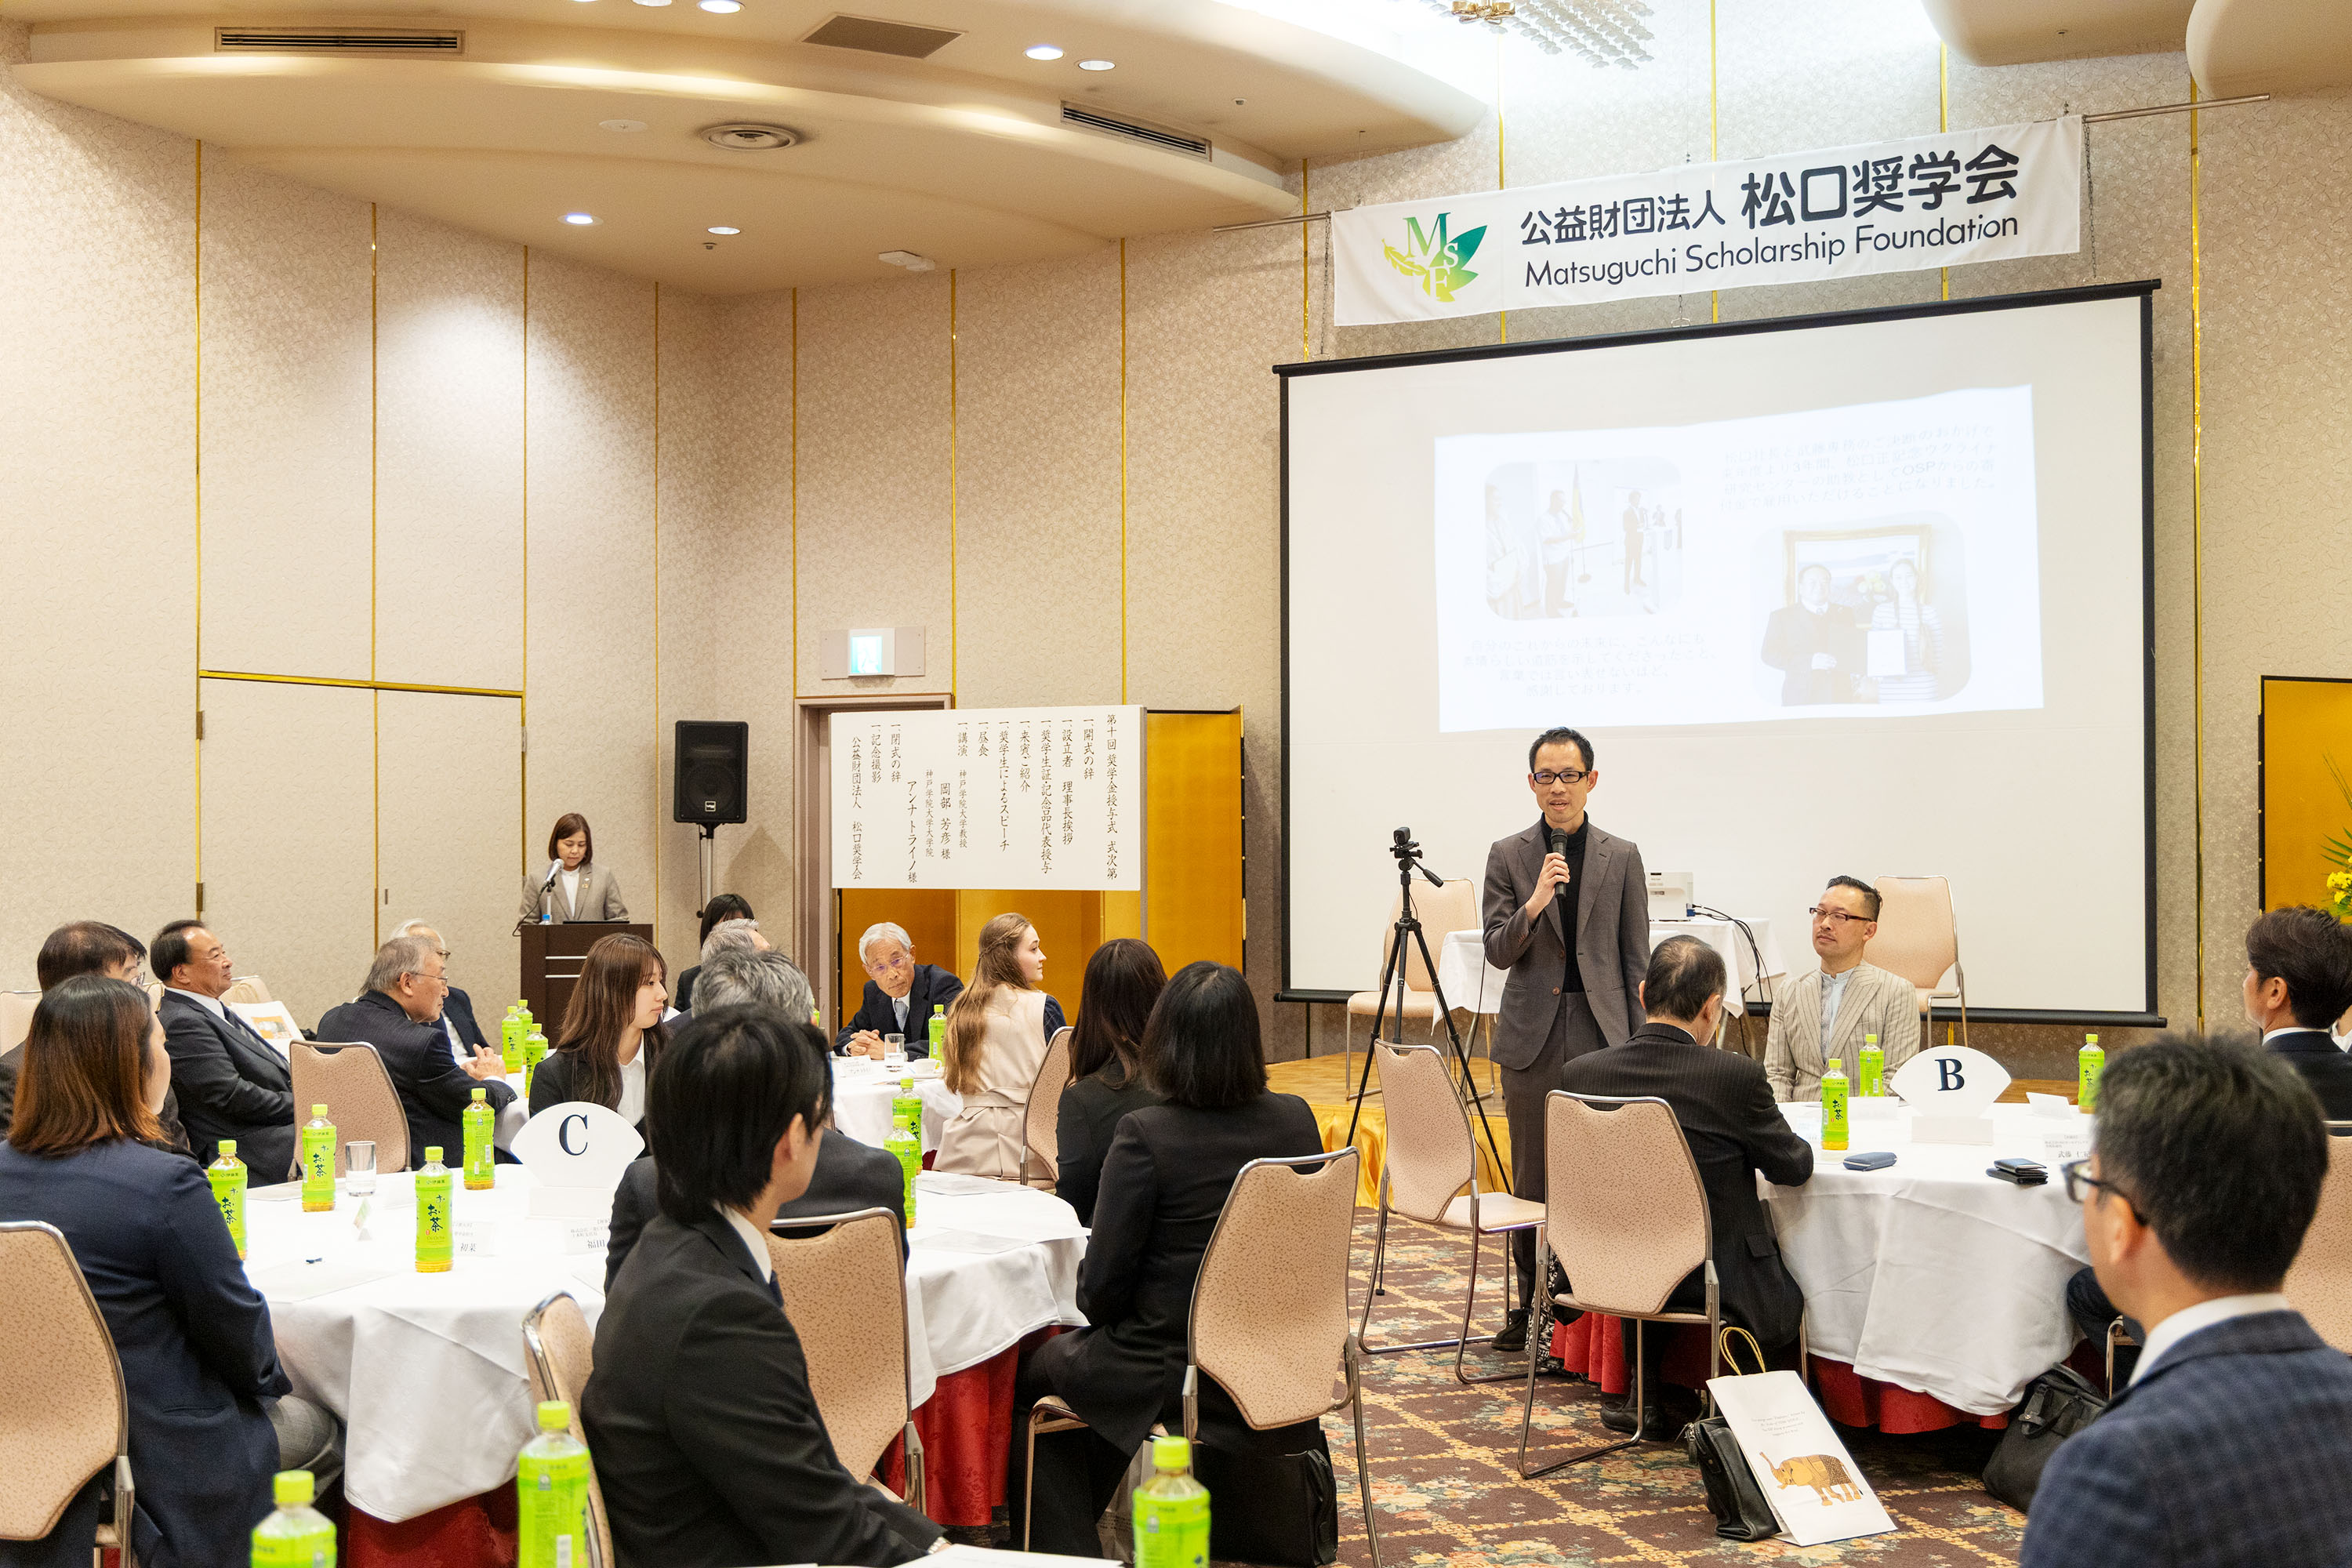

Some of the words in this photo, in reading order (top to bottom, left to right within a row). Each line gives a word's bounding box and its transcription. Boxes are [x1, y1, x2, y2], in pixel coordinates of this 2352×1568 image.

[1520, 190, 1726, 245] 公益財団法人
[1740, 143, 2020, 229] 松口奨学会
[1525, 248, 1676, 288] Matsuguchi
[1686, 230, 1846, 272] Scholarship
[1856, 214, 2018, 254] Foundation
[851, 735, 862, 809] 公益財団法人
[925, 769, 934, 857] 神戸学院大学大学院
[959, 769, 967, 848] 神戸学院大学教授
[1062, 781, 1073, 845] 理事長挨拶
[852, 821, 863, 880] 松口奨学会
[1106, 840, 1118, 880] 式次第
[1934, 1058, 1965, 1091] B
[558, 1114, 588, 1156] C
[427, 1203, 443, 1232] お茶
